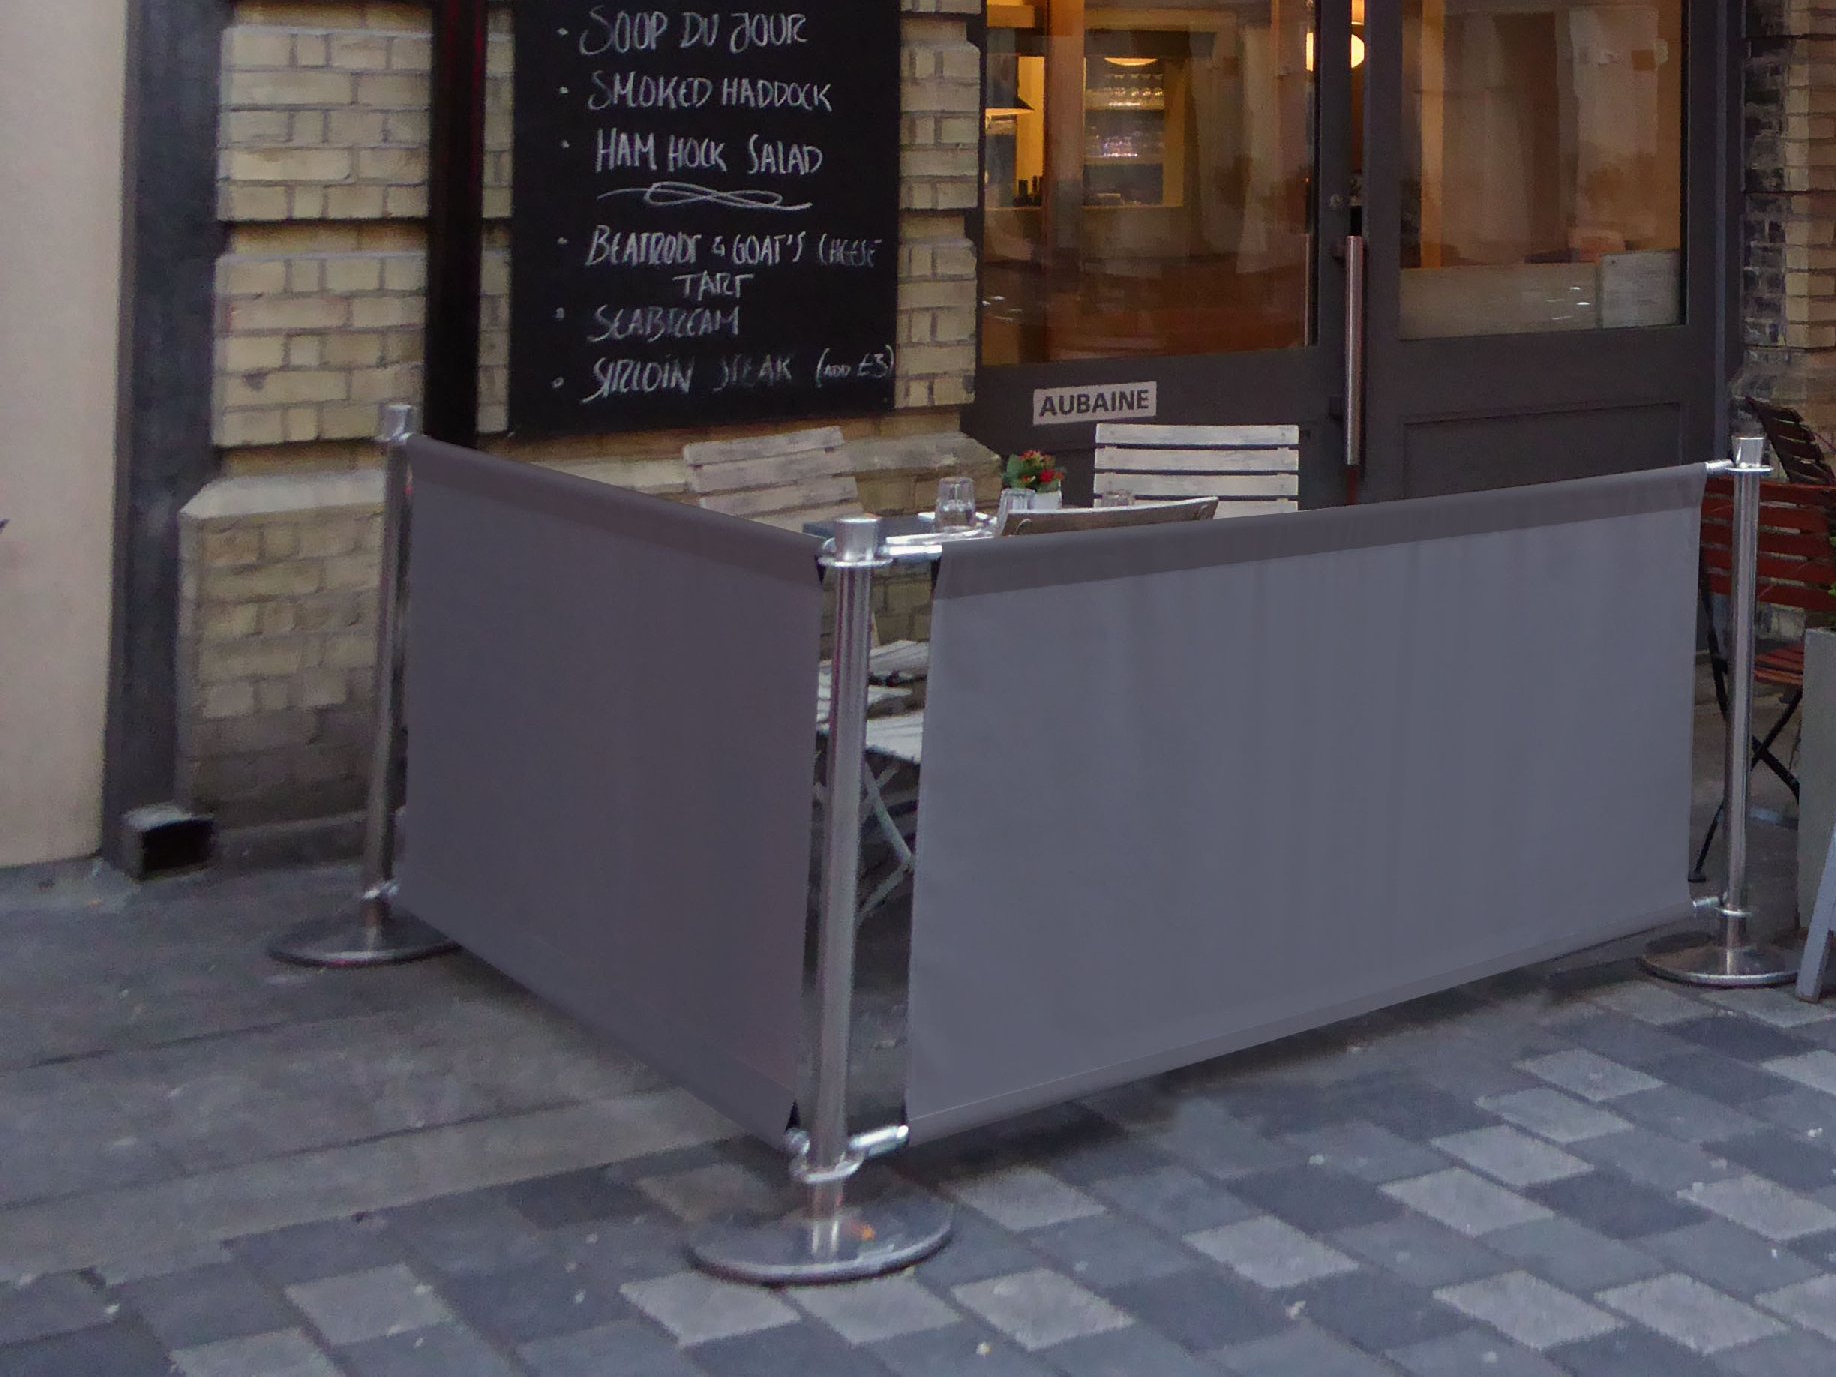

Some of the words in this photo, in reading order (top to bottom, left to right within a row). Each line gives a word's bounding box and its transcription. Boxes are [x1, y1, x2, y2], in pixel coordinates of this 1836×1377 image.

[680, 12, 719, 49] DU
[730, 13, 808, 54] JOUR
[588, 71, 711, 111] SMOKED
[722, 78, 832, 112] HADDOCK
[596, 128, 657, 173] HAM
[668, 135, 727, 174] HOCK
[748, 134, 823, 174] SALAD
[731, 230, 806, 264] GOAT'S
[672, 270, 754, 301] TART
[587, 304, 739, 342] SEABREAM
[580, 355, 696, 404] SIRLOIN
[1039, 389, 1149, 417] AUBAINE
